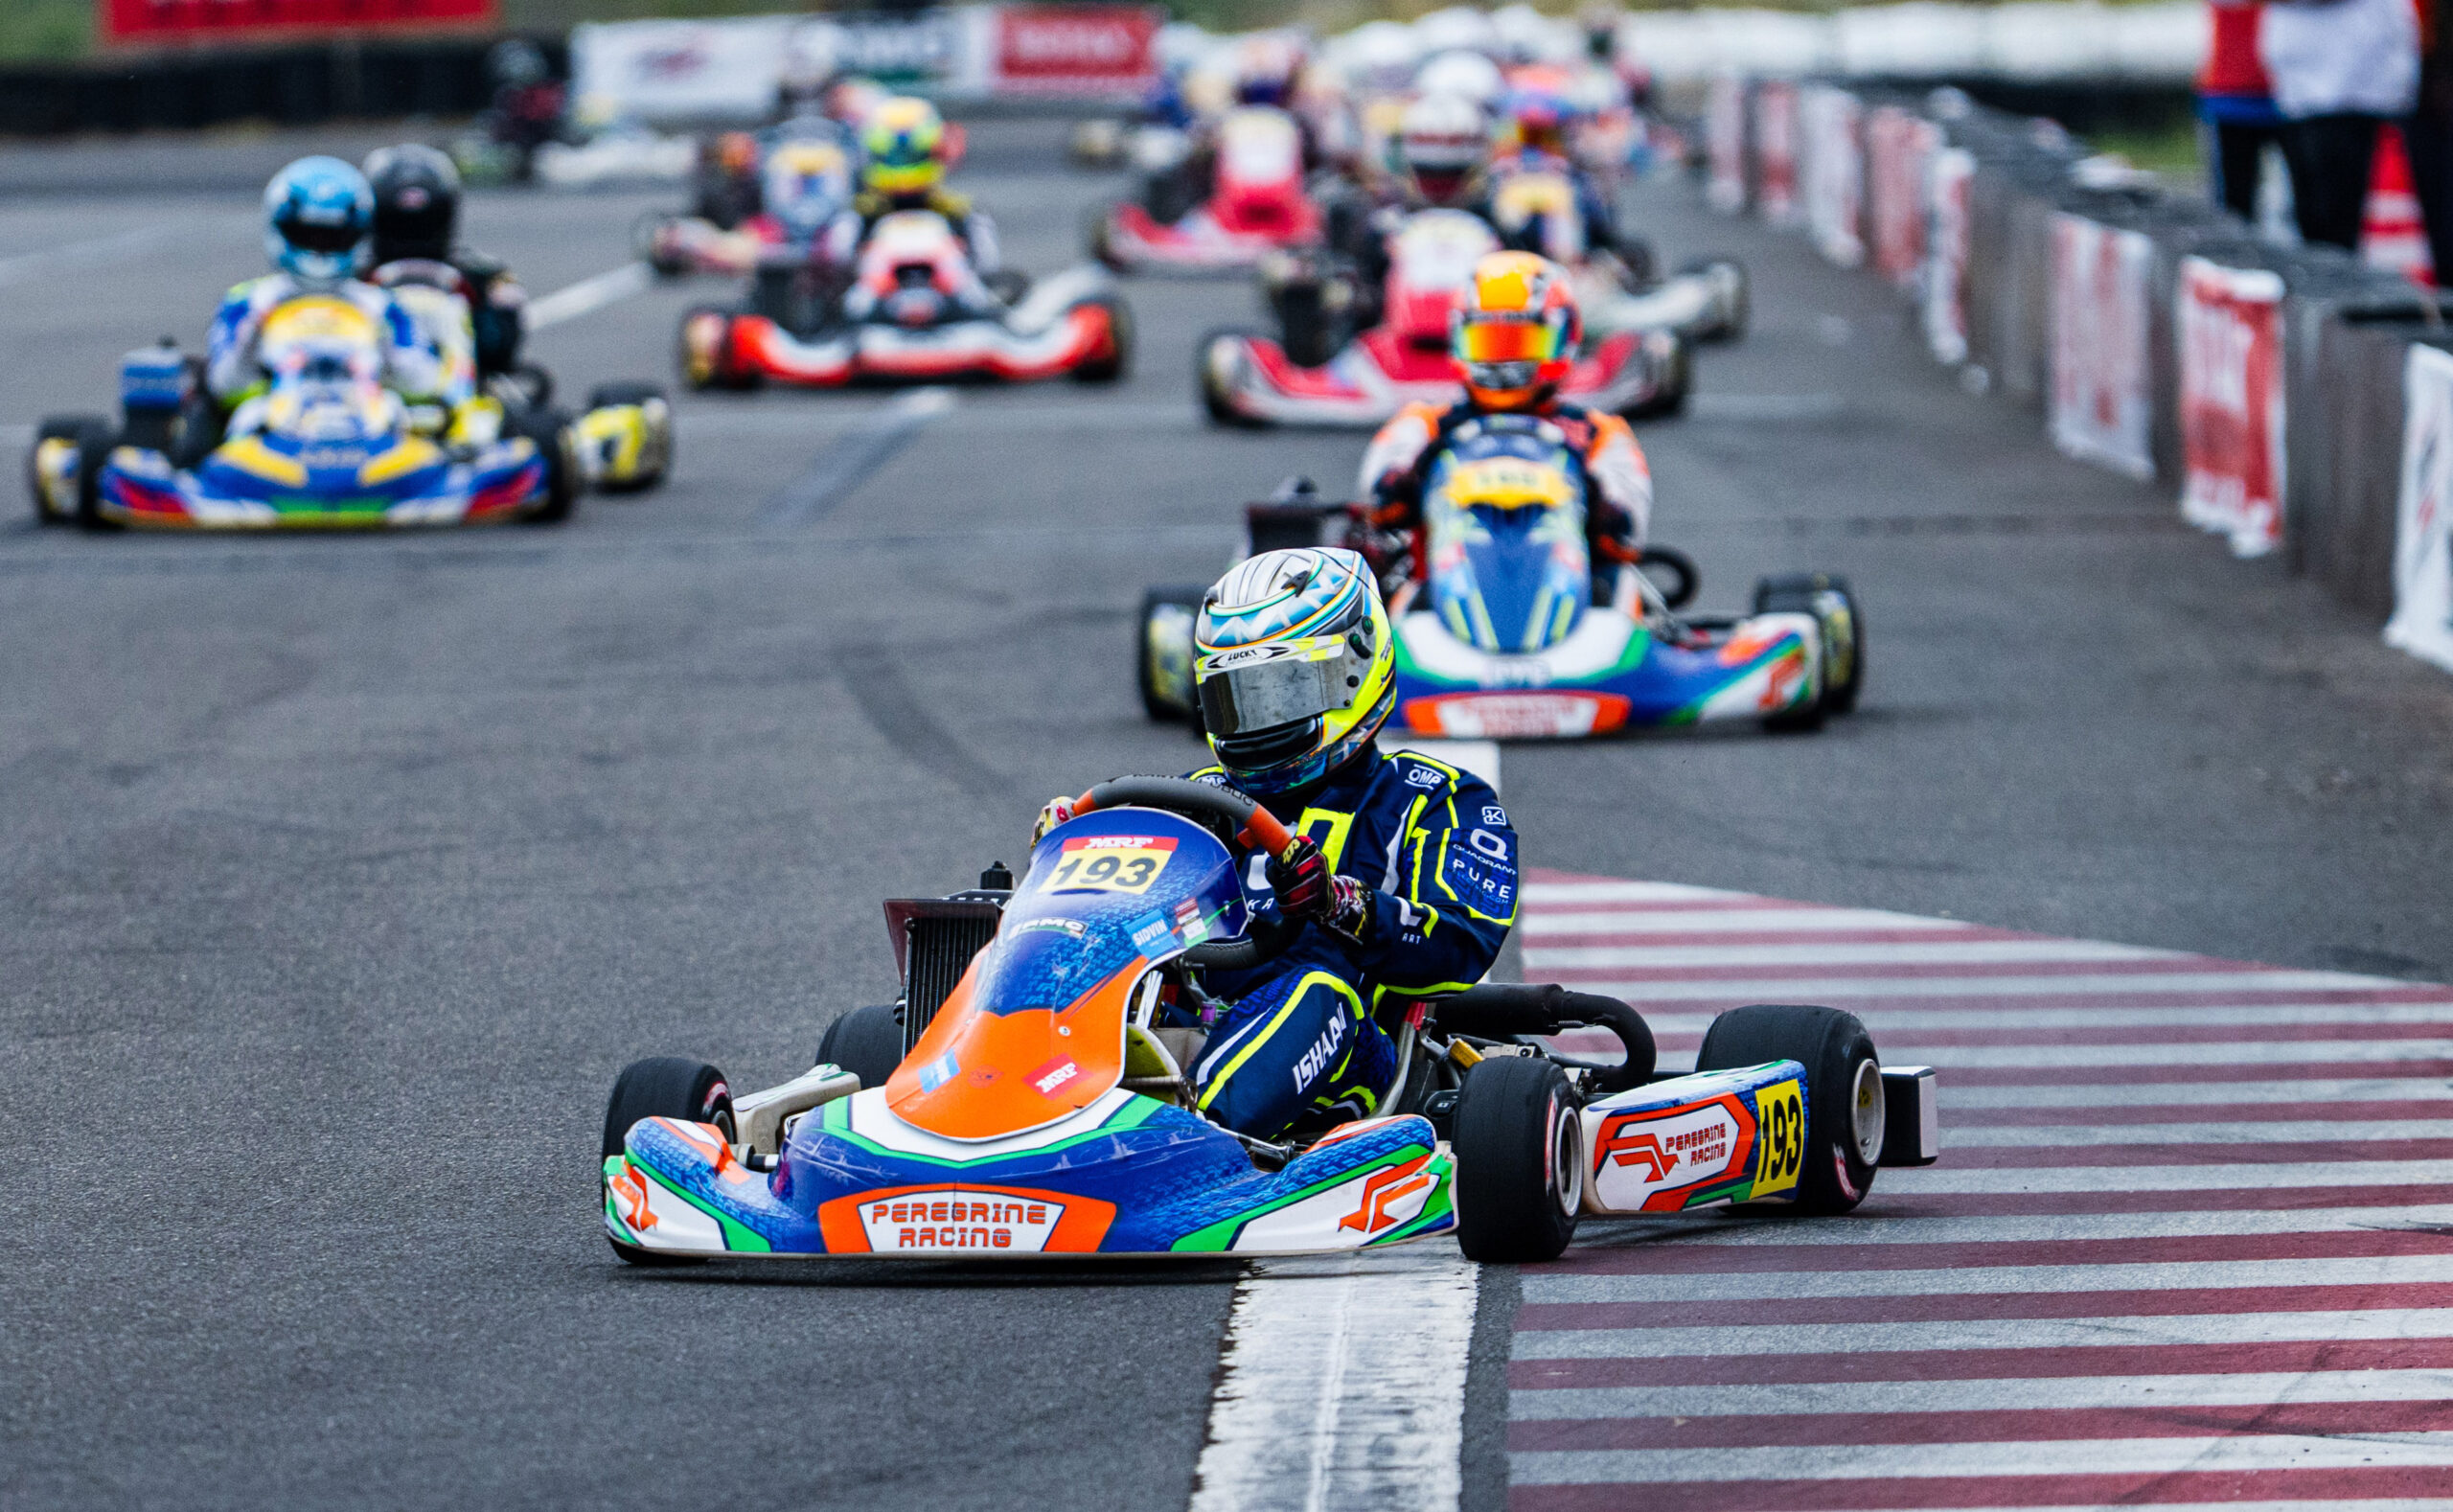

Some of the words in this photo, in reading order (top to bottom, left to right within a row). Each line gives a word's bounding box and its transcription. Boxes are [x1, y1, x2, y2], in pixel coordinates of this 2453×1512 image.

[1227, 650, 1257, 661] LUCKY
[1409, 768, 1442, 785] OMP
[1084, 836, 1154, 849] MRF
[1054, 856, 1158, 886] 193
[1453, 843, 1518, 876] QUADRANT
[1453, 859, 1511, 899] PURE
[1132, 918, 1168, 947] SIDVIN
[1035, 1062, 1078, 1094] MRF
[1665, 1123, 1727, 1153] PEREGRINE
[1758, 1094, 1801, 1183] 193
[1690, 1142, 1727, 1166] RACING
[872, 1202, 1046, 1225] PEREGRINE
[899, 1227, 1012, 1248] RACING
